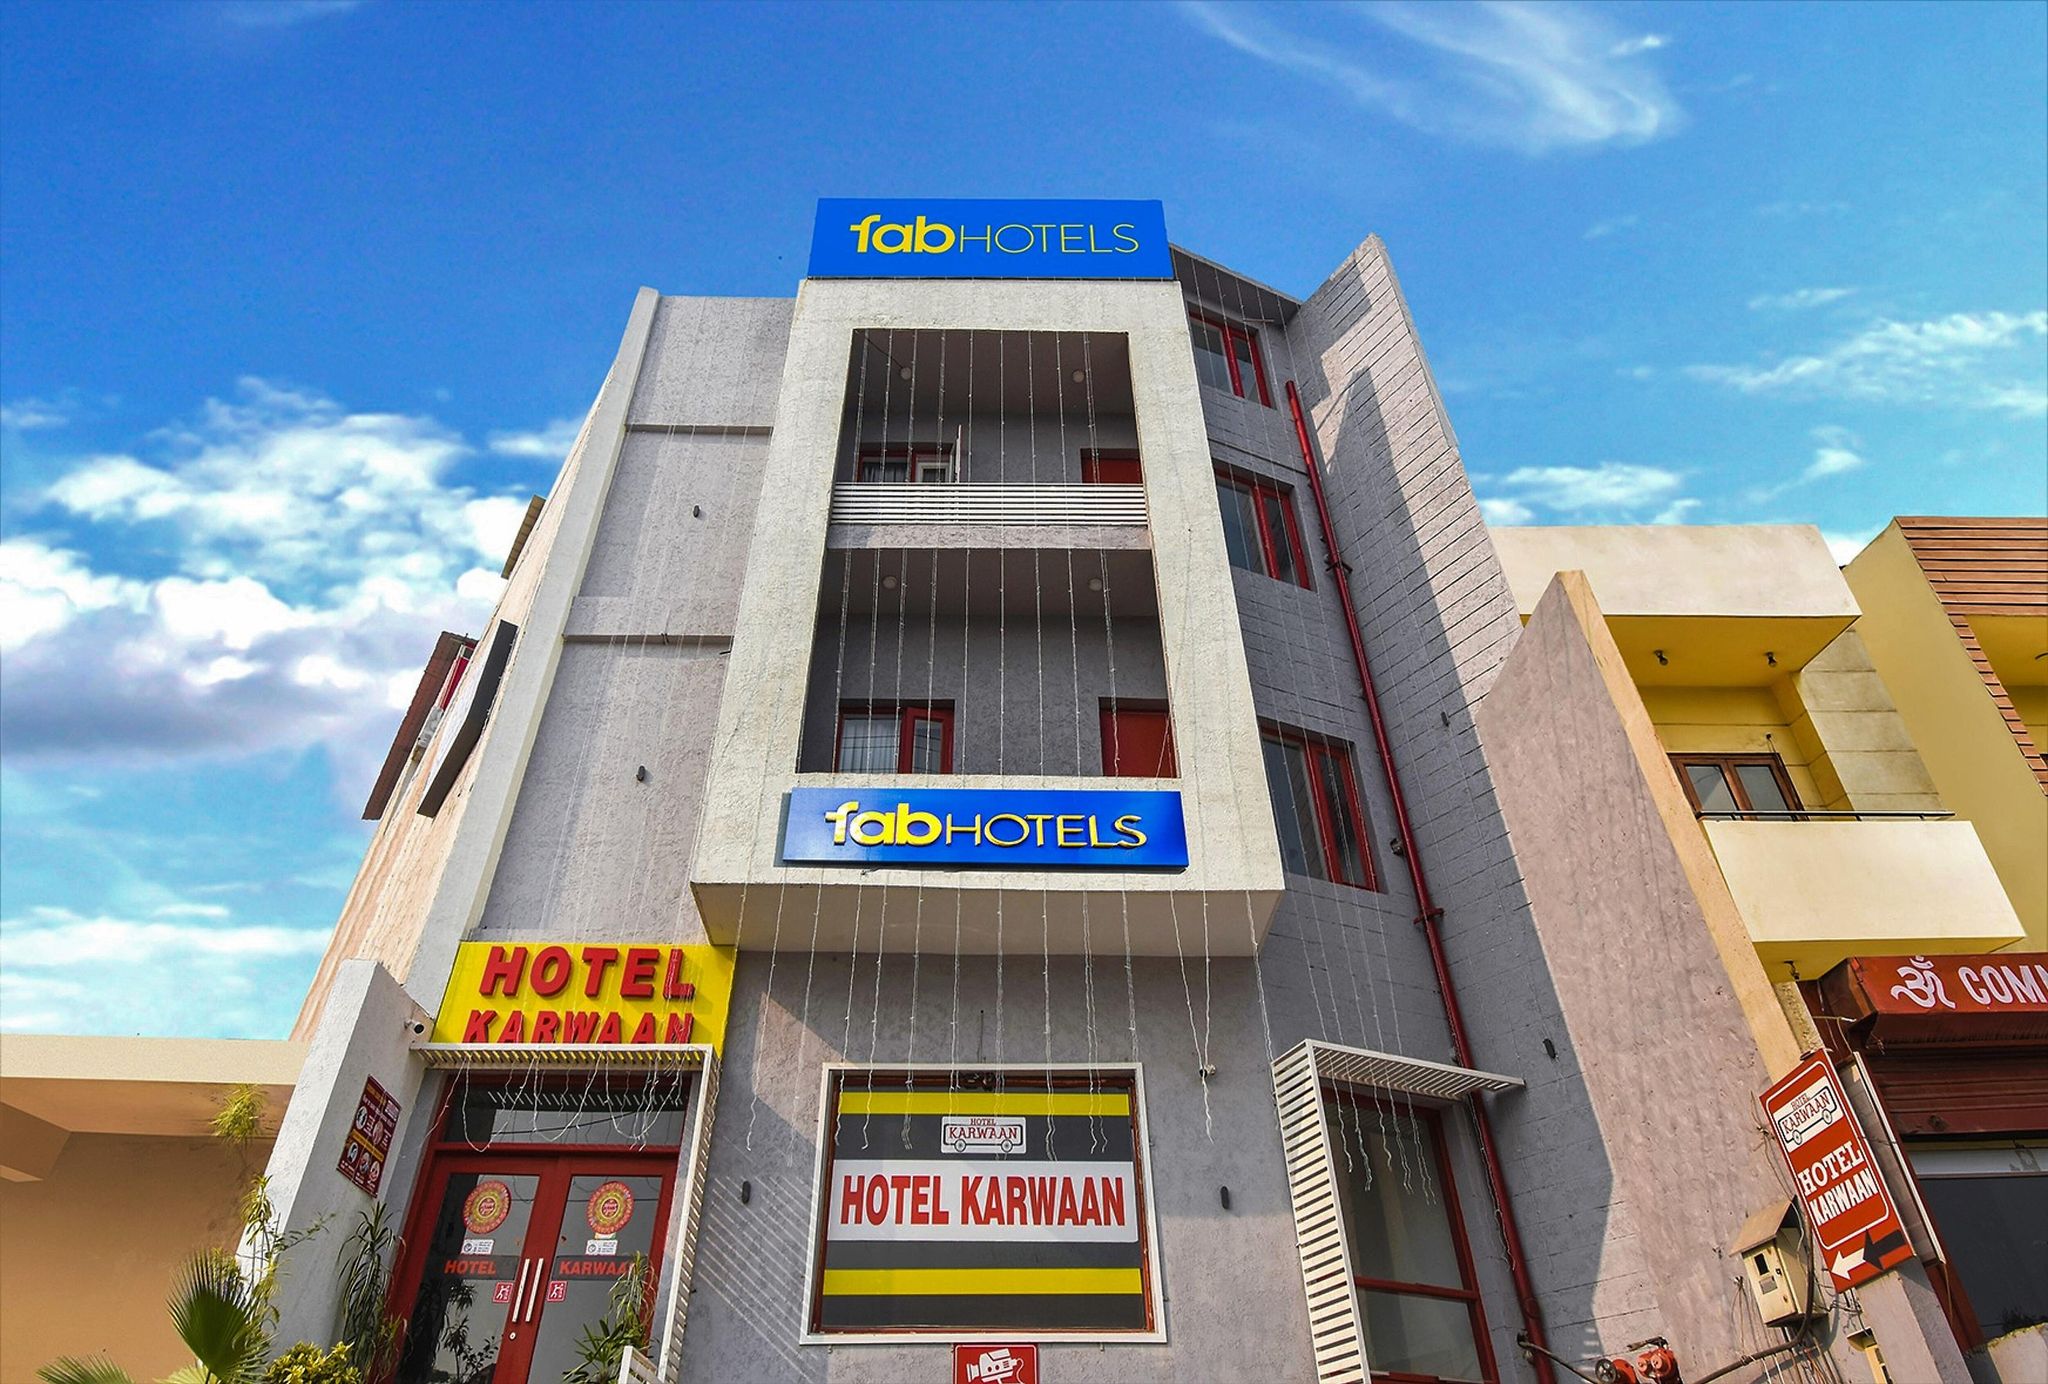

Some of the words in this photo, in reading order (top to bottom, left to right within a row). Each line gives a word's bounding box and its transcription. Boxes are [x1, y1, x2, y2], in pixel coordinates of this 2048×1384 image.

[850, 214, 1139, 254] fabHOTELS
[825, 801, 1148, 848] fabHOTELS
[479, 946, 695, 999] HOTEL
[462, 1010, 694, 1044] KARWAAN
[949, 1127, 1017, 1139] KARWAAN
[970, 1118, 996, 1126] HOTEL
[1782, 1091, 1830, 1134] KARWAAN
[1798, 1141, 1864, 1196] HOTEL
[840, 1174, 949, 1225] HOTEL
[961, 1176, 1125, 1226] KARWAAN
[1810, 1168, 1878, 1226] KARWAAN
[444, 1260, 496, 1275] HOTEL
[559, 1260, 628, 1275] KARWAA
